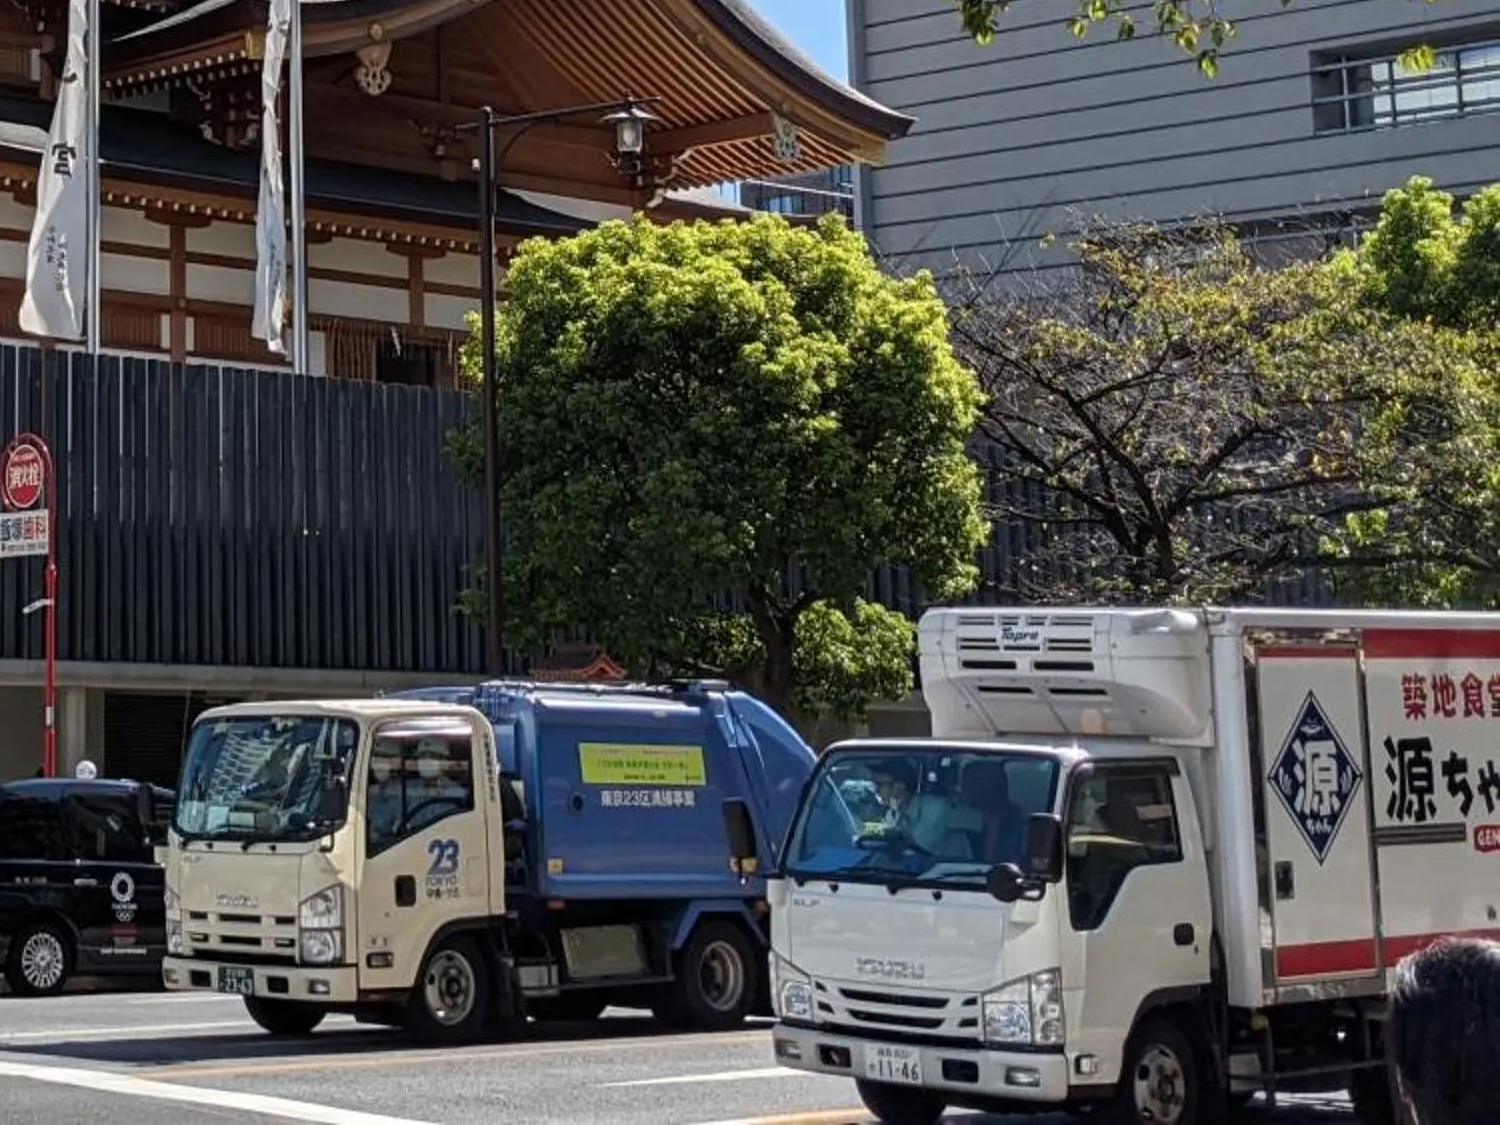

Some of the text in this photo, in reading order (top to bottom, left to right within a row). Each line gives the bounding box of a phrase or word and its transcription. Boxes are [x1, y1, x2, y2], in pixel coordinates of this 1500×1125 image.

[1292, 739, 1341, 816] 源
[427, 838, 460, 875] 23
[879, 1059, 919, 1081] 11-46
